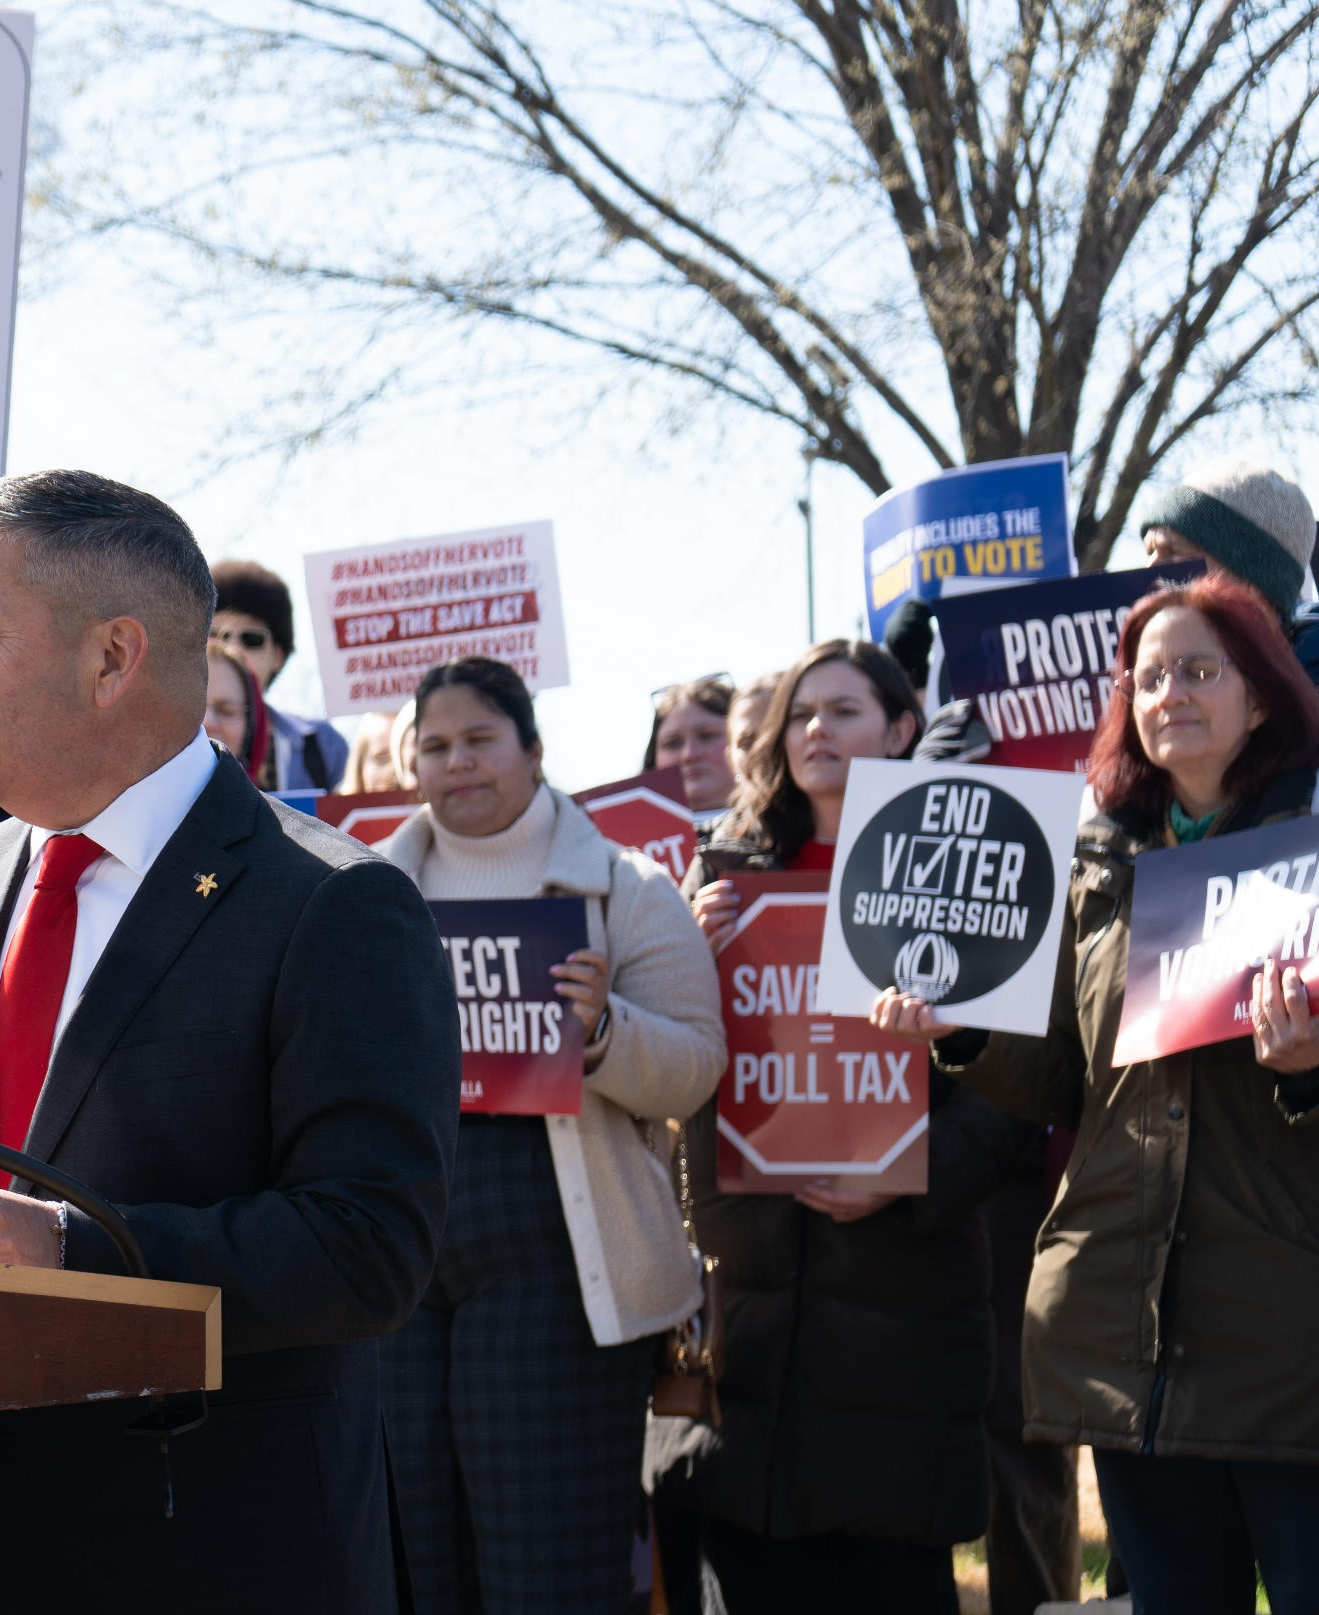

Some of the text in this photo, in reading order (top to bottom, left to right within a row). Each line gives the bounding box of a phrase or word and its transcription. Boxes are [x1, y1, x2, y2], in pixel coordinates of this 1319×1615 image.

[915, 506, 1042, 551] INCLUDES THE
[919, 544, 957, 583] TO
[963, 535, 1044, 576] VOTE
[345, 594, 526, 645] STOP THE SAVE ACT
[977, 677, 1095, 743] VOTING
[921, 785, 991, 836] END
[643, 833, 686, 878] CT
[853, 891, 1029, 940] SUPPRESSION
[735, 1052, 911, 1104] POLL TAX
